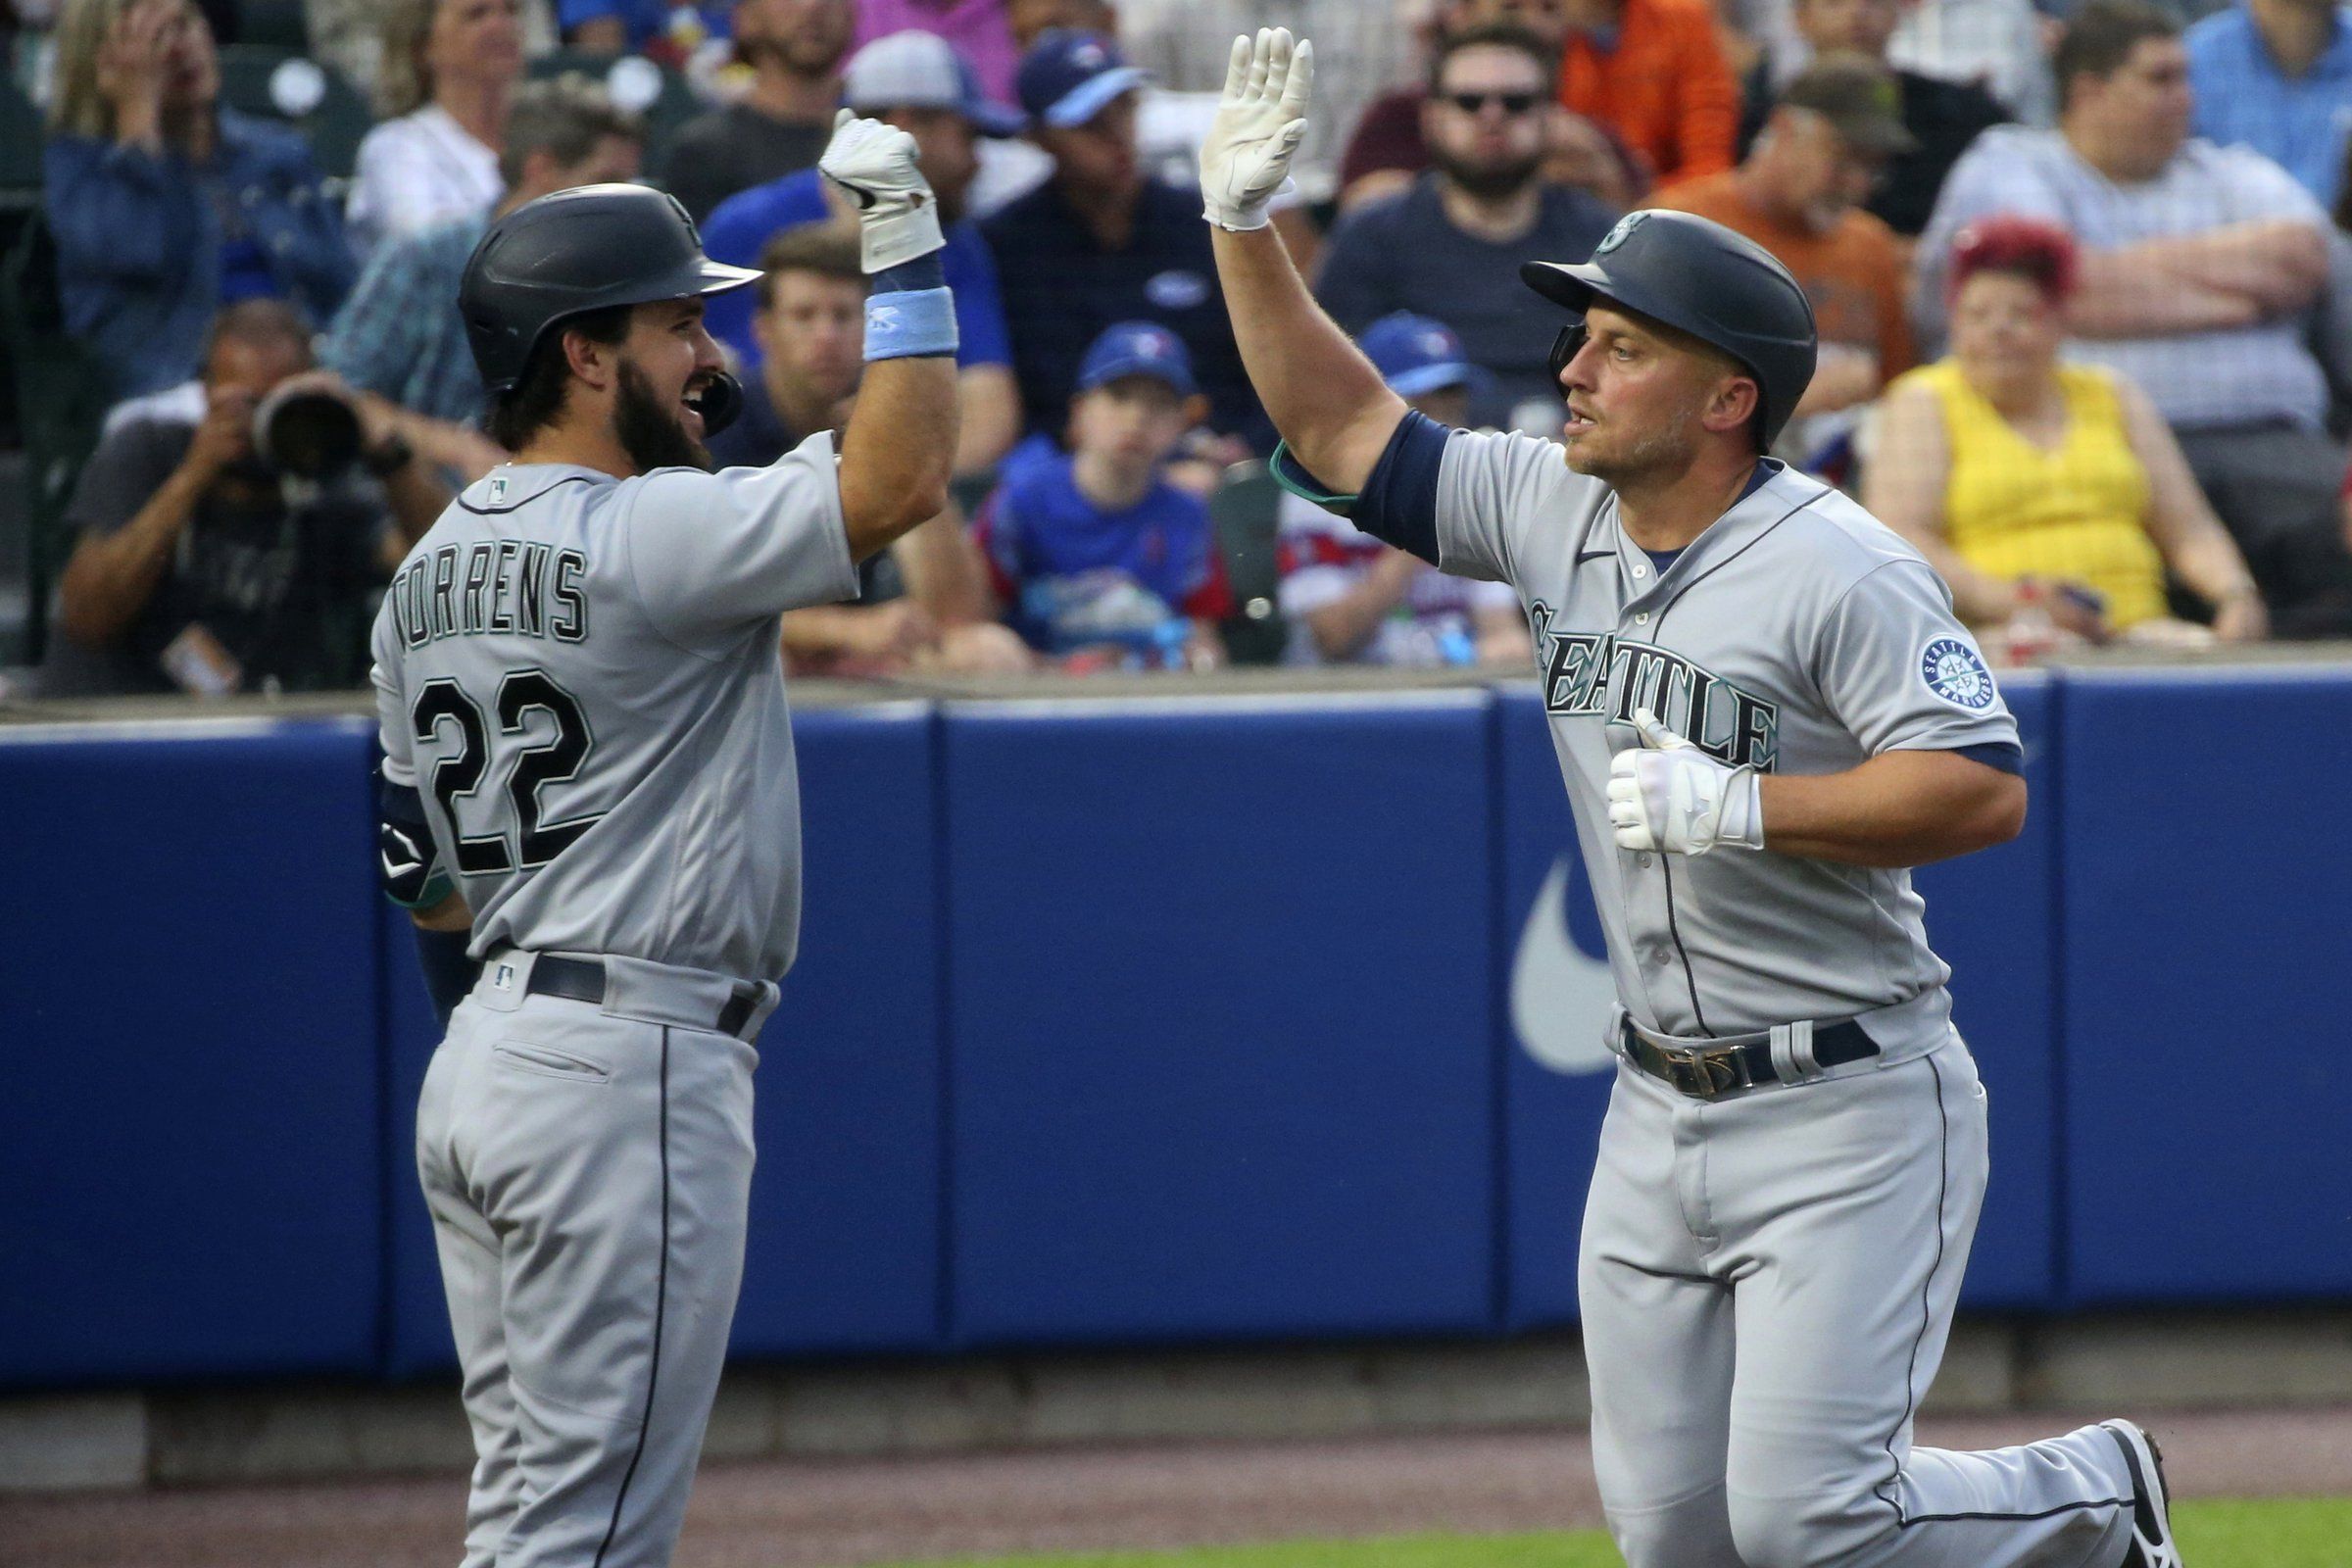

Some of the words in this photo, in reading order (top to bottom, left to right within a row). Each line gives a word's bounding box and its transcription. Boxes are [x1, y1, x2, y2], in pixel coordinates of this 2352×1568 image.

[393, 540, 587, 652] TORRENS
[1925, 641, 1977, 674] SEATTLE
[1938, 677, 1991, 708] MARINERS
[412, 667, 610, 875] 22
